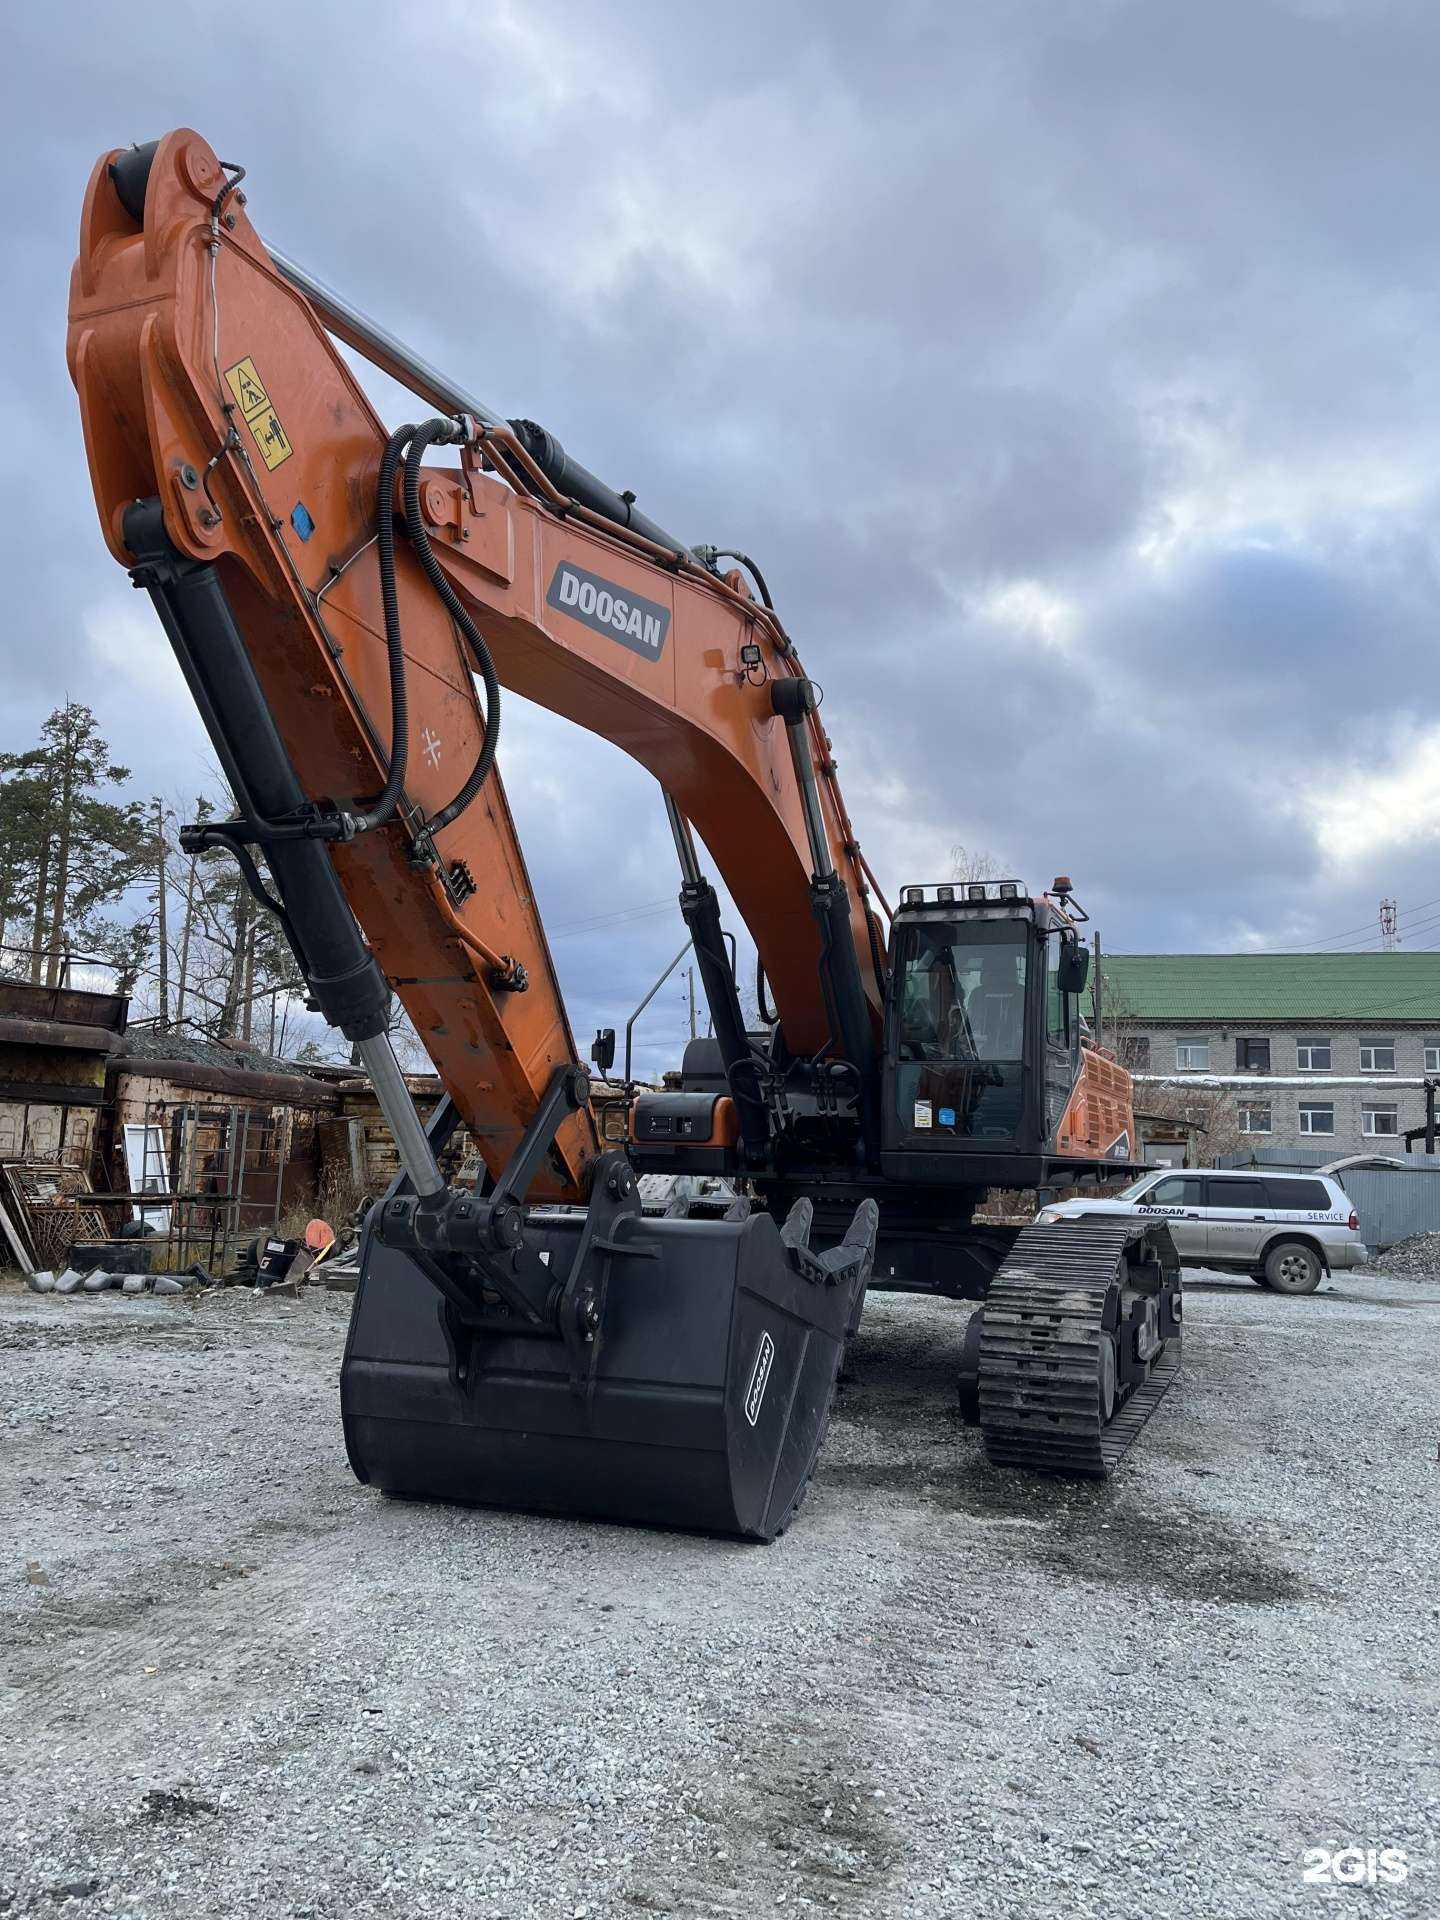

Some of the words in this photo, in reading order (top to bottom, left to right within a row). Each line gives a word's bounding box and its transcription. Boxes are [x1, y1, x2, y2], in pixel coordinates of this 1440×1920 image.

[559, 570, 661, 648] DOOSAN
[1138, 1207, 1185, 1216] DOOSAN
[1307, 1212, 1344, 1221] SERVICE
[750, 1342, 770, 1416] DOOSAN
